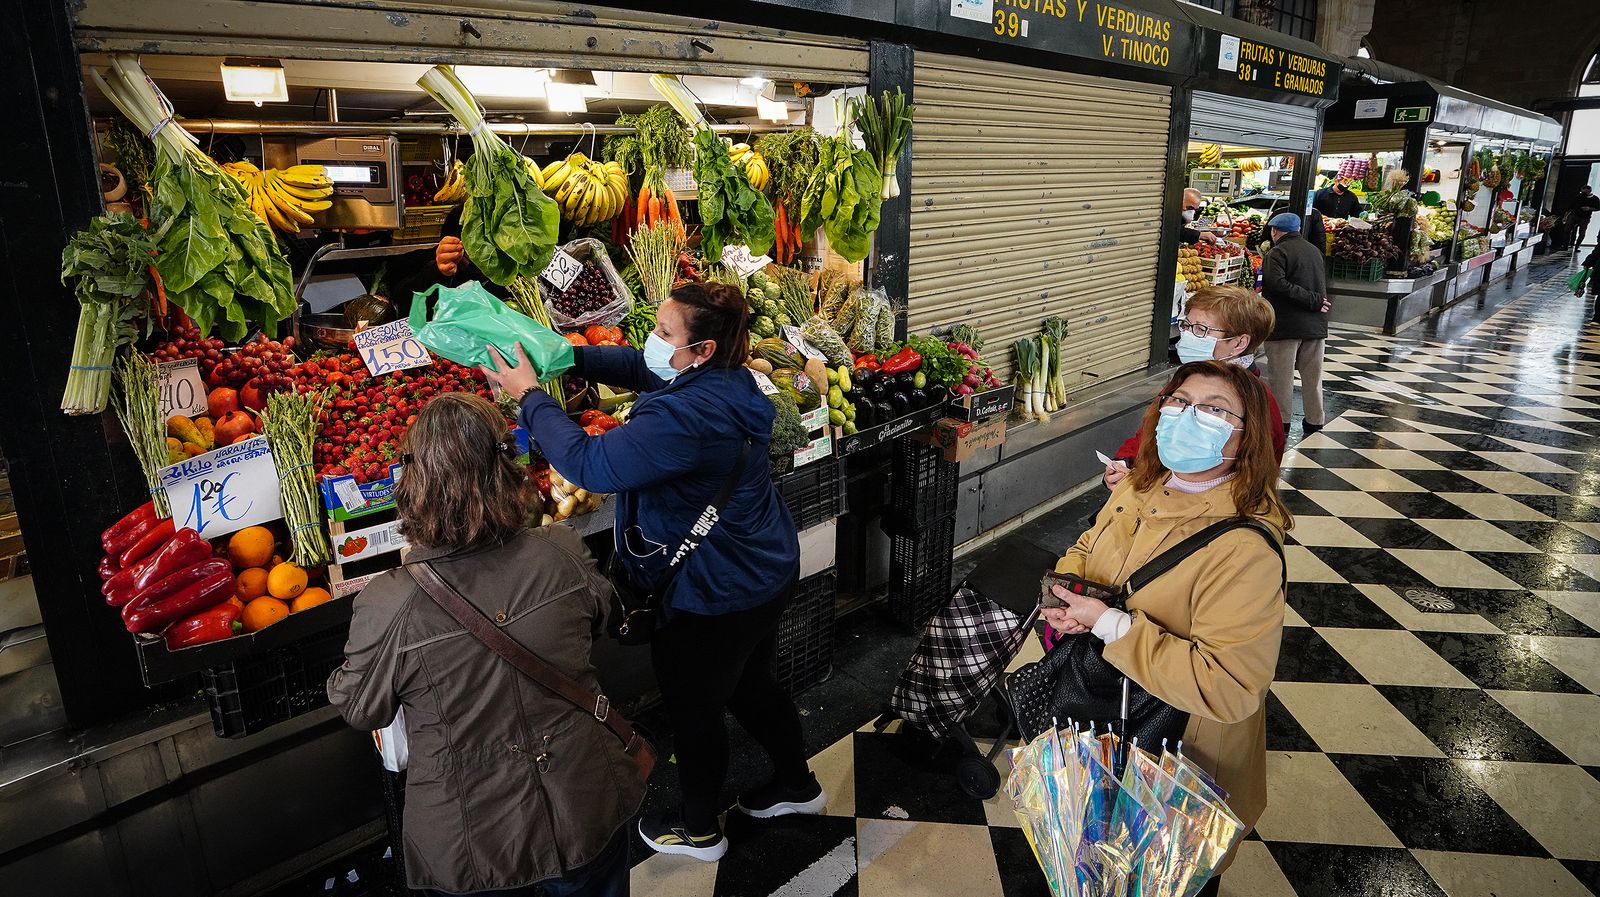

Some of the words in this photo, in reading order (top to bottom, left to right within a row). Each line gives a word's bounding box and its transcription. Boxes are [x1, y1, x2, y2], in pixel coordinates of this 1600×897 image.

[994, 9, 1019, 38] 39
[1076, 0, 1088, 22] Y
[1097, 4, 1172, 42] VERDURAS
[1102, 34, 1115, 57] V.
[1121, 38, 1169, 67] TINOCO
[1240, 41, 1275, 65] FRUTAS
[1279, 50, 1285, 67] Y
[1288, 53, 1327, 77] VERDURAS
[1238, 63, 1251, 81] 38
[1274, 71, 1281, 87] E
[1283, 73, 1324, 95] GRANADOS
[213, 437, 267, 461] NARANJAS
[362, 488, 390, 499] VIRTUDES
